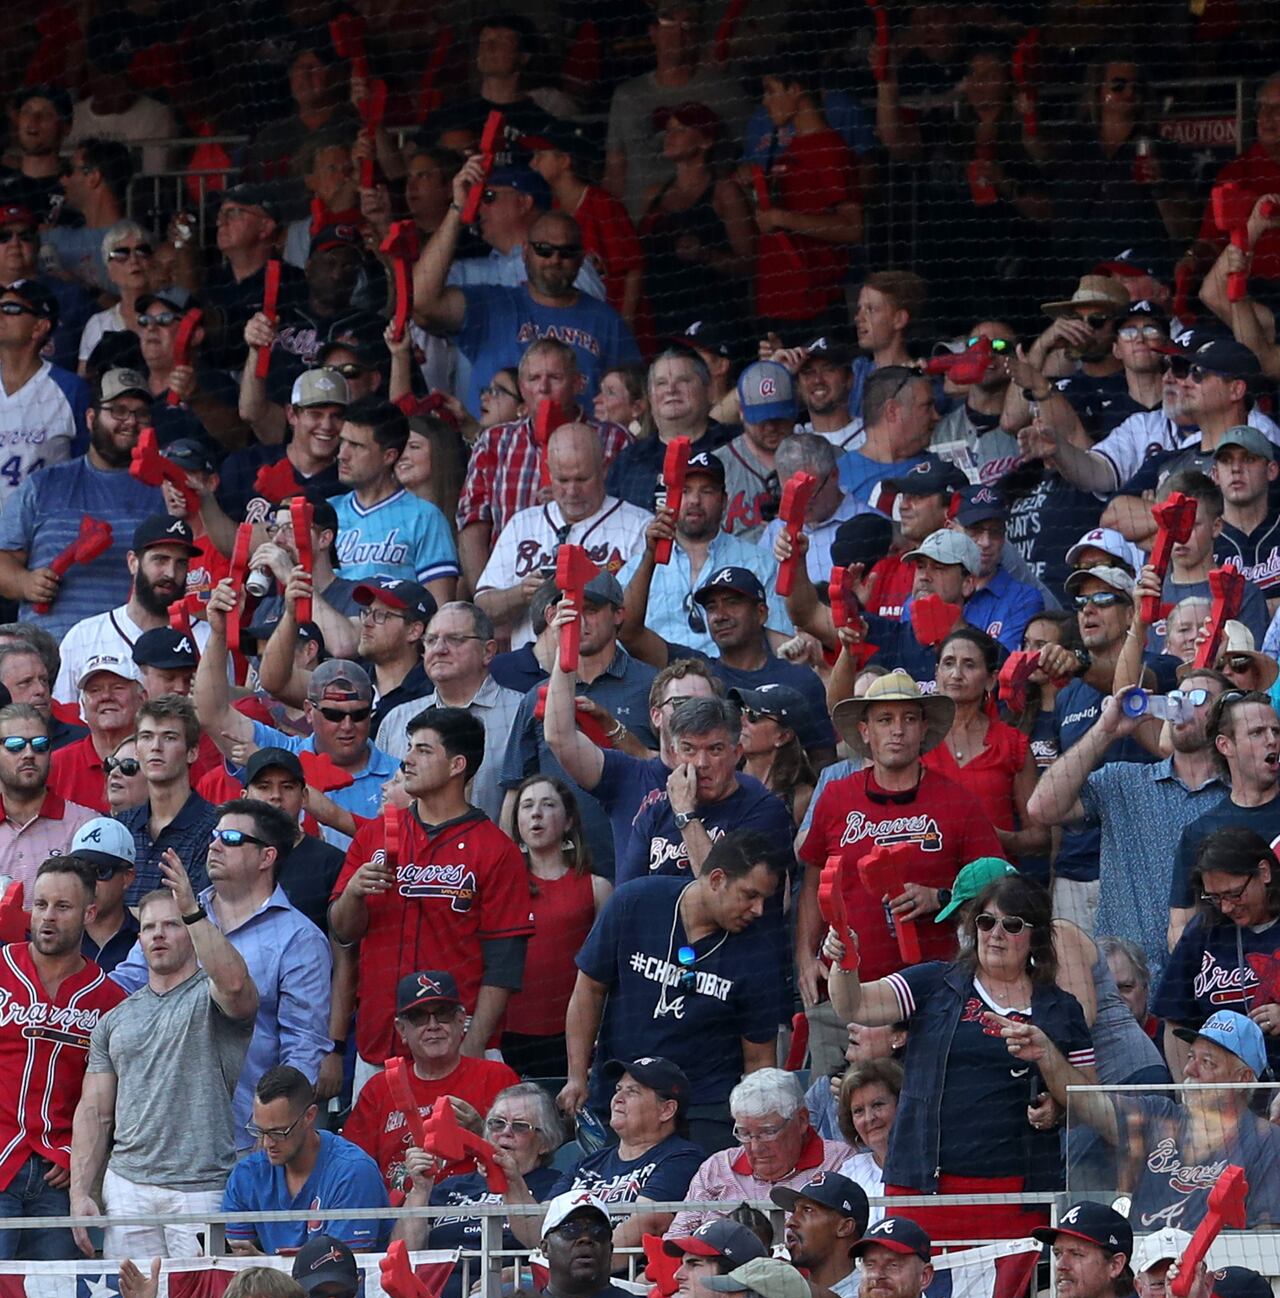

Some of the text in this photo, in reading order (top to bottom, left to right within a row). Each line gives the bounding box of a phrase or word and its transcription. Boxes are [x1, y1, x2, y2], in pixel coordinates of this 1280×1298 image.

[167, 520, 187, 535] A
[336, 529, 408, 567] lanta
[712, 568, 732, 584] A
[173, 636, 192, 654] A
[82, 827, 102, 843] A
[841, 812, 927, 847] Braves
[1060, 1206, 1081, 1224] A
[871, 1219, 895, 1235] A
